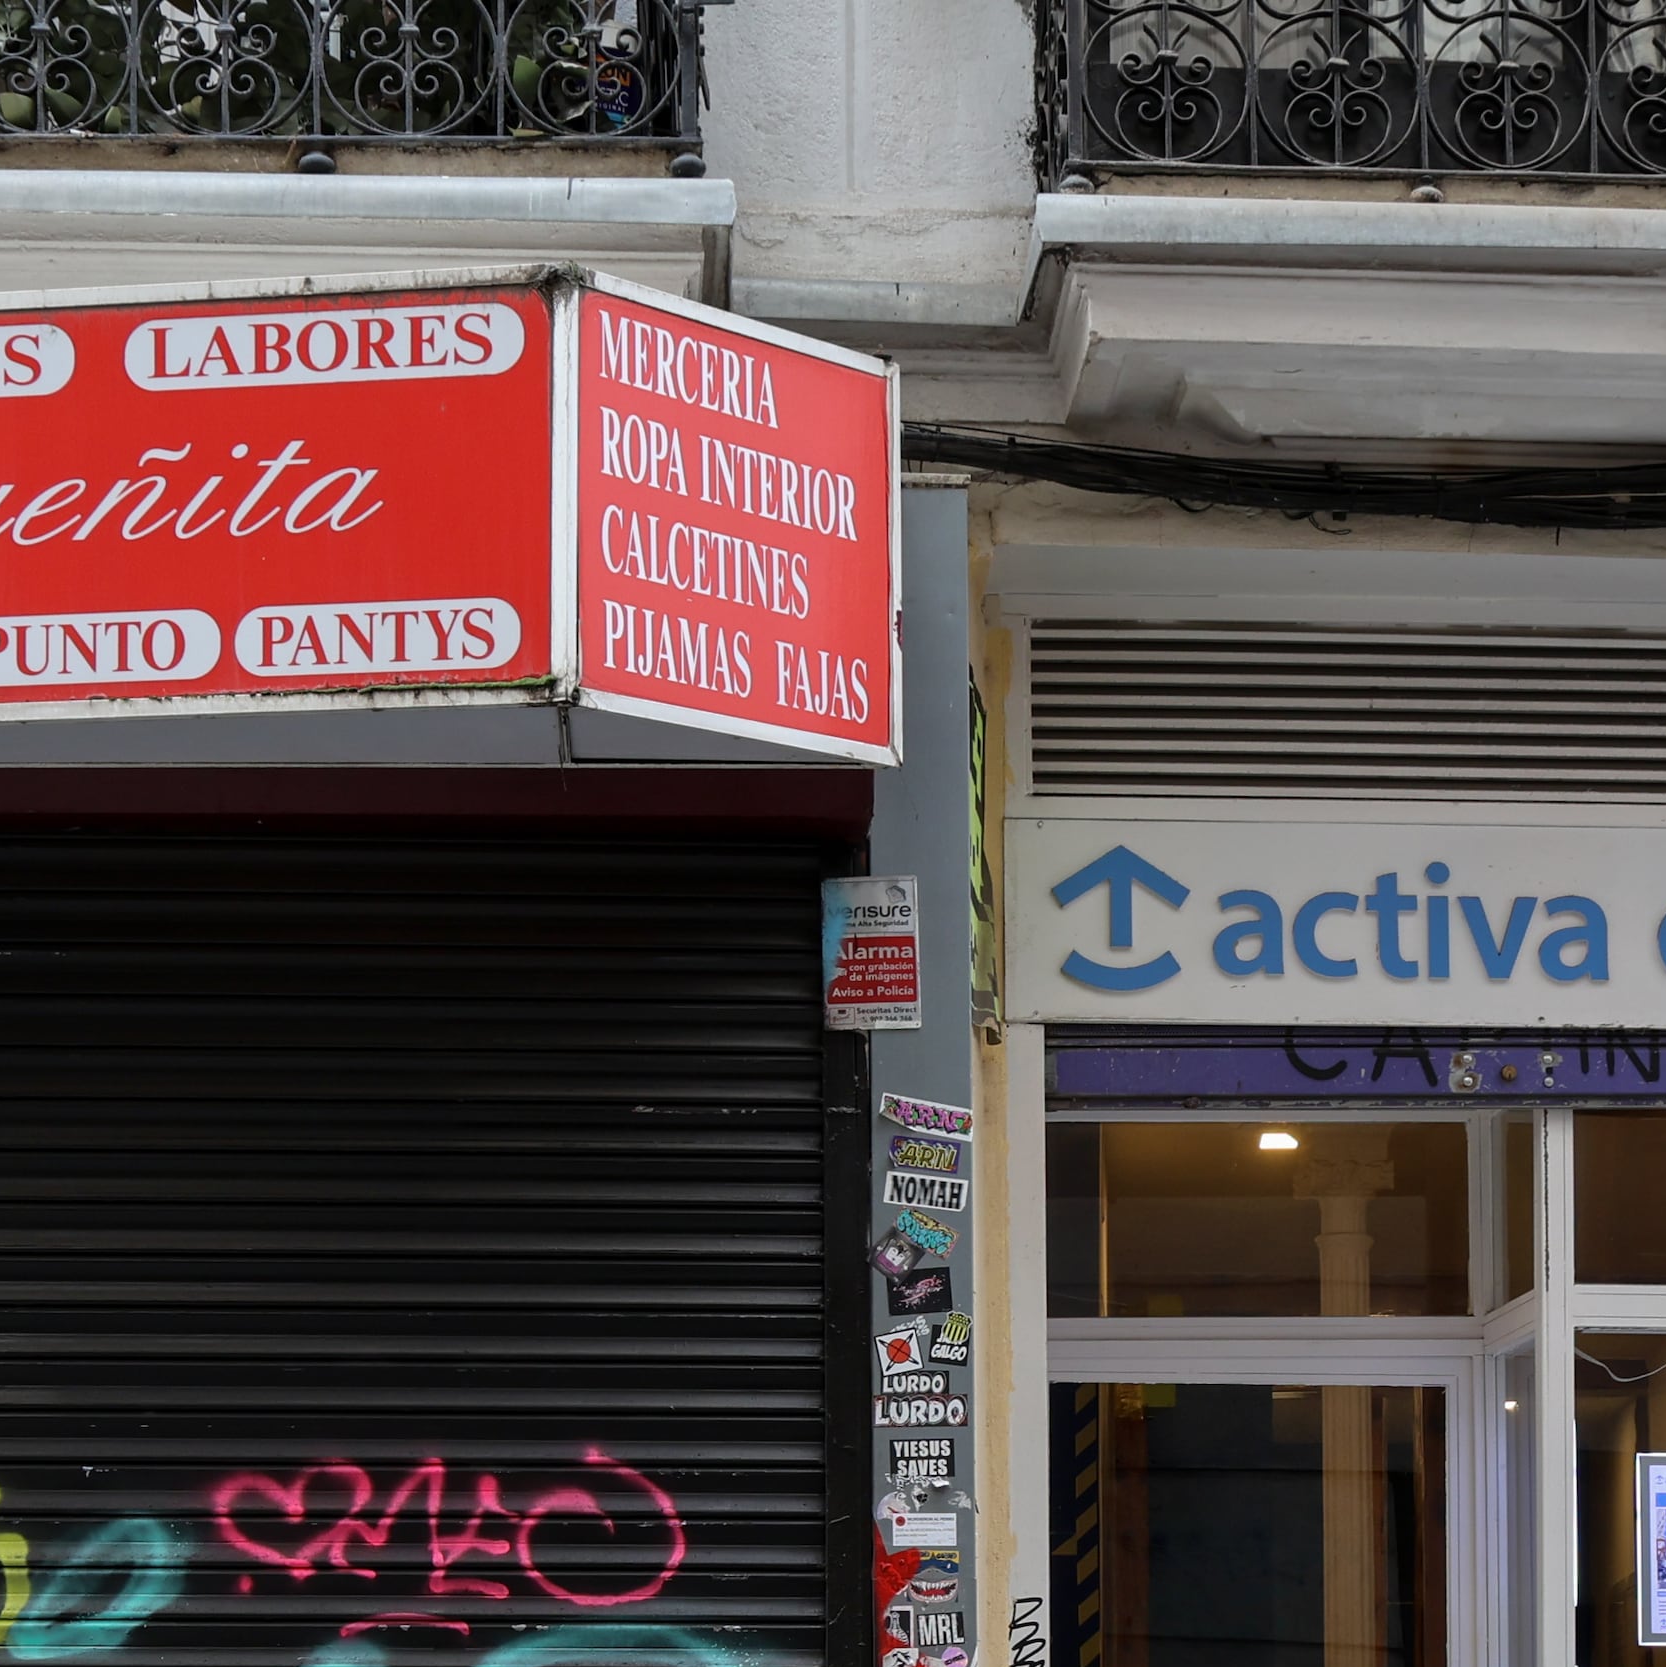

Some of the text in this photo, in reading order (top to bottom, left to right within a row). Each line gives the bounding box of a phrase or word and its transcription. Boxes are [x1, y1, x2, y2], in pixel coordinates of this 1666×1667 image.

[148, 304, 494, 380] LABORES
[598, 308, 780, 430] MERCERIA
[600, 405, 859, 543] ROPA INTERIOR
[600, 502, 810, 621] CALCETINES
[256, 607, 496, 669] PANTYS
[602, 598, 870, 725] PIJAMAS FAJAS
[874, 919, 909, 928] Seguridad
[1211, 861, 1610, 984] activa
[839, 942, 914, 961] Alarma
[849, 962, 914, 973] con grabación
[849, 972, 914, 983] de imágenes
[832, 986, 914, 998] Aviso a Policía
[893, 1006, 917, 1014] Direct
[889, 1174, 964, 1210] NOMAH
[931, 1342, 968, 1363] GALGO
[883, 1374, 945, 1394] LURDO
[874, 1399, 965, 1426] LURDO
[893, 1440, 951, 1458] YIESUS
[897, 1459, 949, 1477] SAVES
[917, 1613, 965, 1646] MRL
